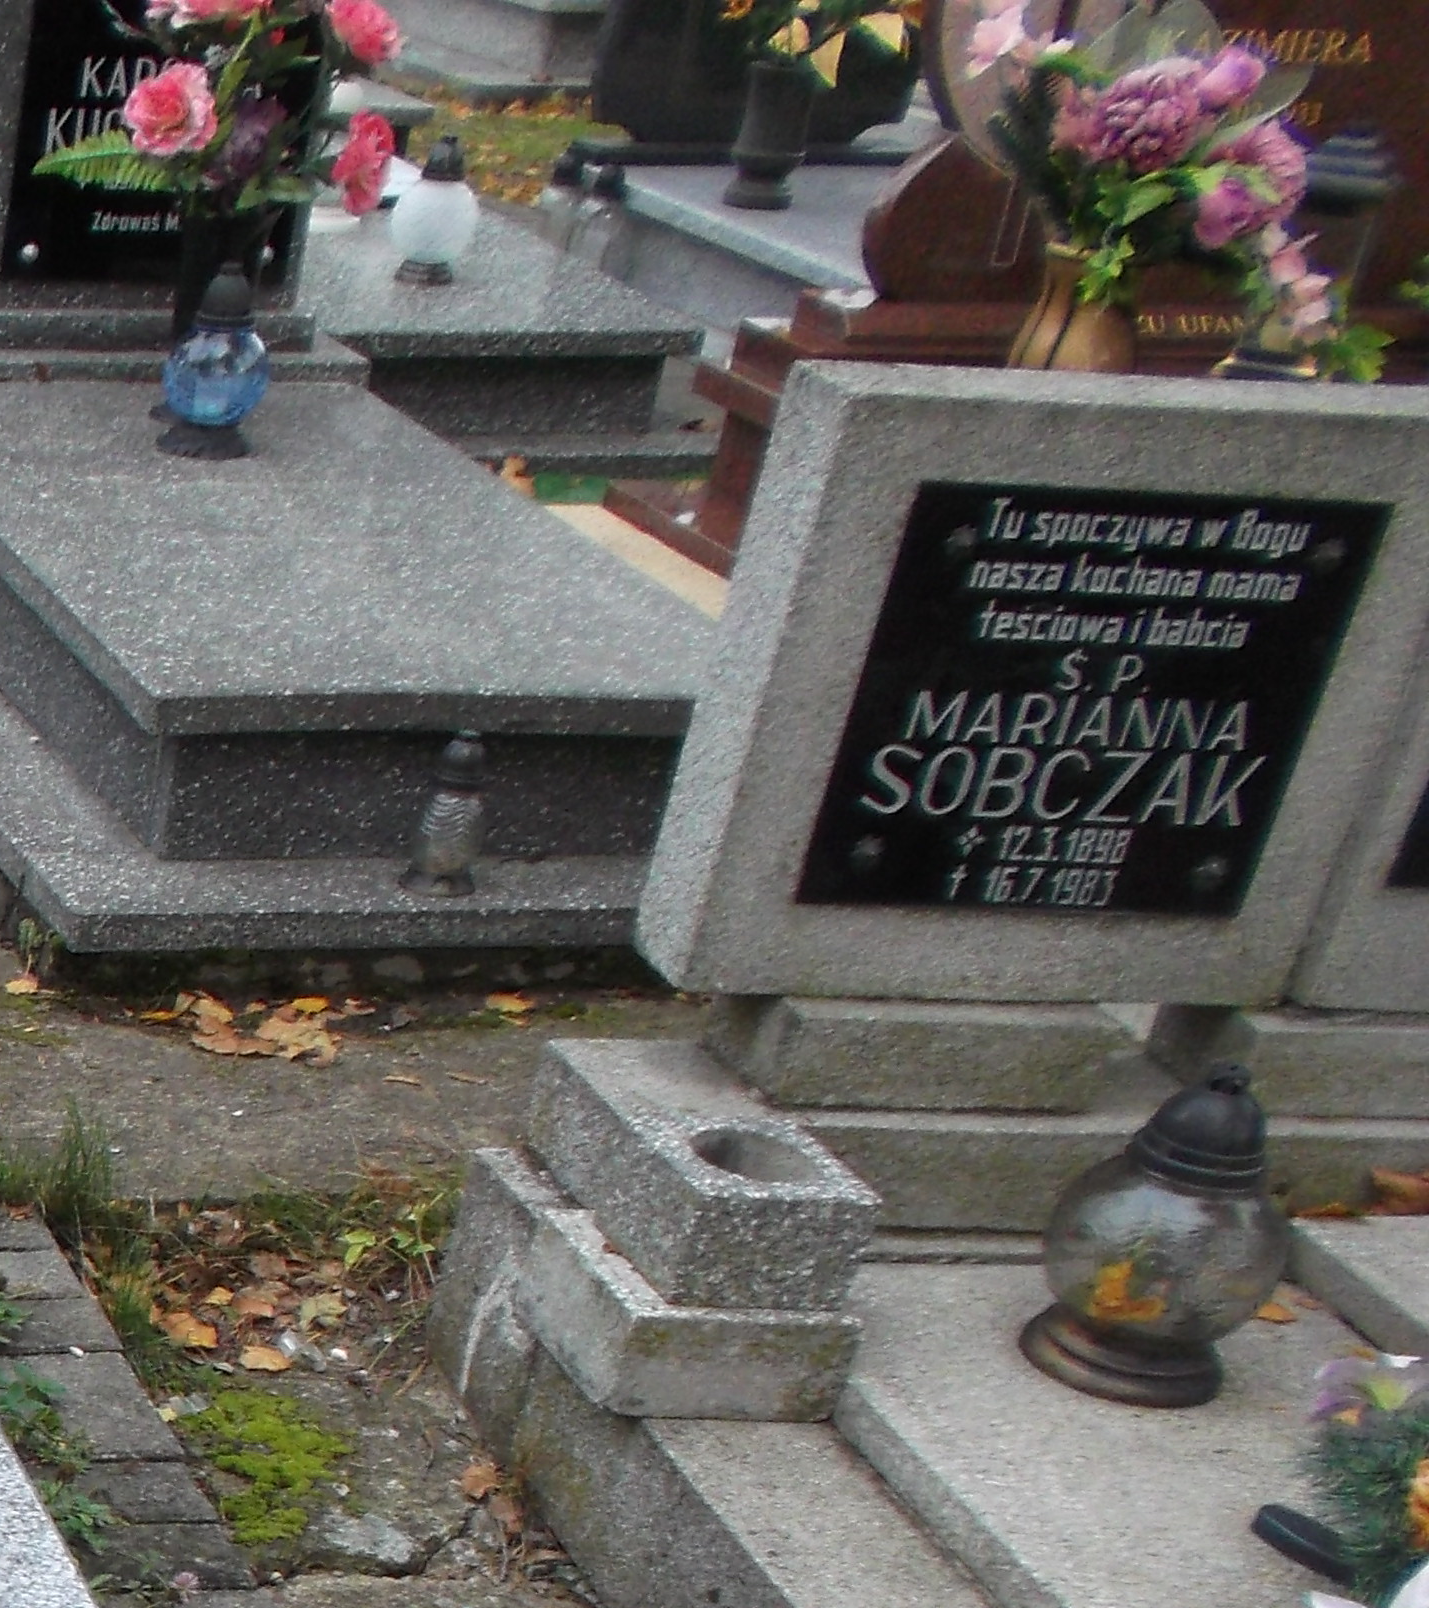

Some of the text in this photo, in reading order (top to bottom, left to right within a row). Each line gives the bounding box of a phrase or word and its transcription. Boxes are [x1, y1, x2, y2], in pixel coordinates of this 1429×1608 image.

[988, 497, 1312, 559] Tu spoczywa w Bogu
[968, 551, 1303, 602] nasza kochana mama
[979, 598, 1251, 650] teściowa i babcia
[904, 690, 1249, 752] MARIANNA
[860, 742, 1267, 827] SOBCZAK
